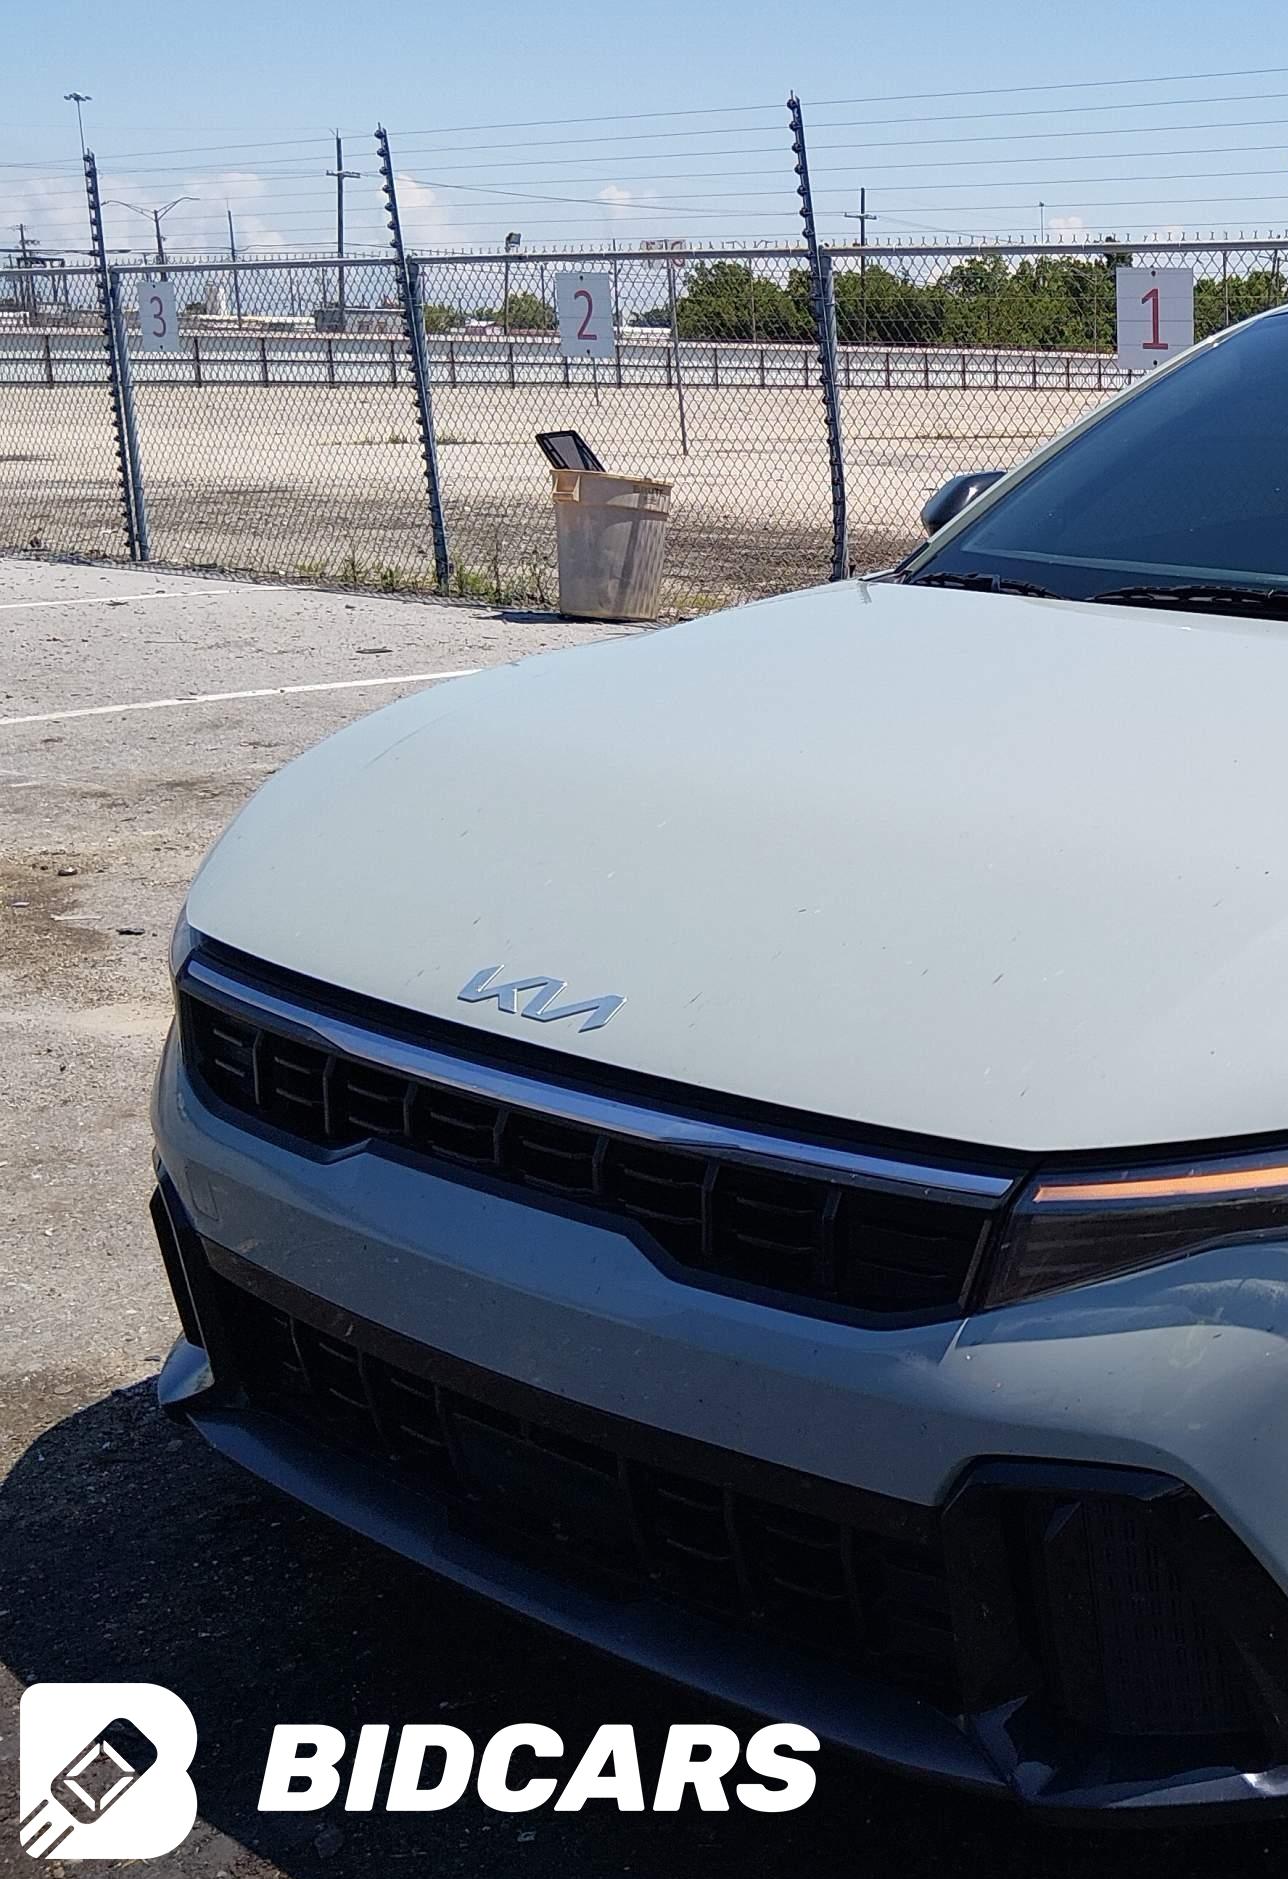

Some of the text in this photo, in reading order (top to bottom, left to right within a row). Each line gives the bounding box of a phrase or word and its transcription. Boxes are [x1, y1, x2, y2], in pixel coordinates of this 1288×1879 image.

[150, 295, 167, 338] 3
[574, 289, 598, 341] 2
[1141, 288, 1169, 350] 1
